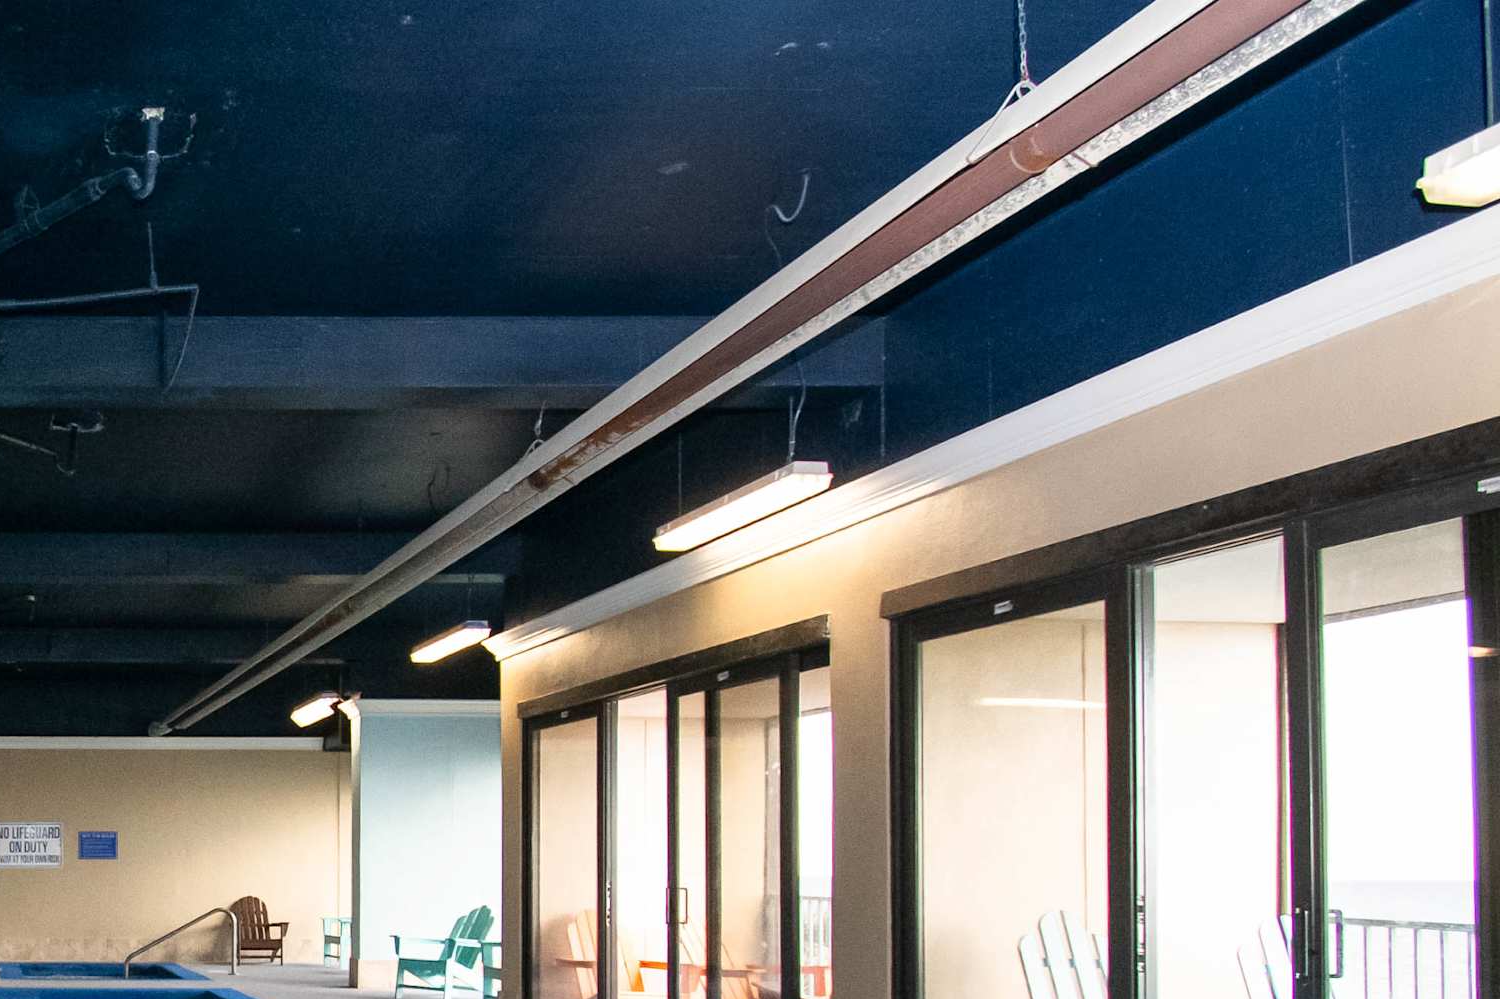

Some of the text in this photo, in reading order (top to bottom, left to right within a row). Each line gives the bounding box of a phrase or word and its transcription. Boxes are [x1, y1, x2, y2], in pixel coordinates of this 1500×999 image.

[12, 826, 60, 839] LIFEGUARD
[9, 840, 48, 853] ON DUTY
